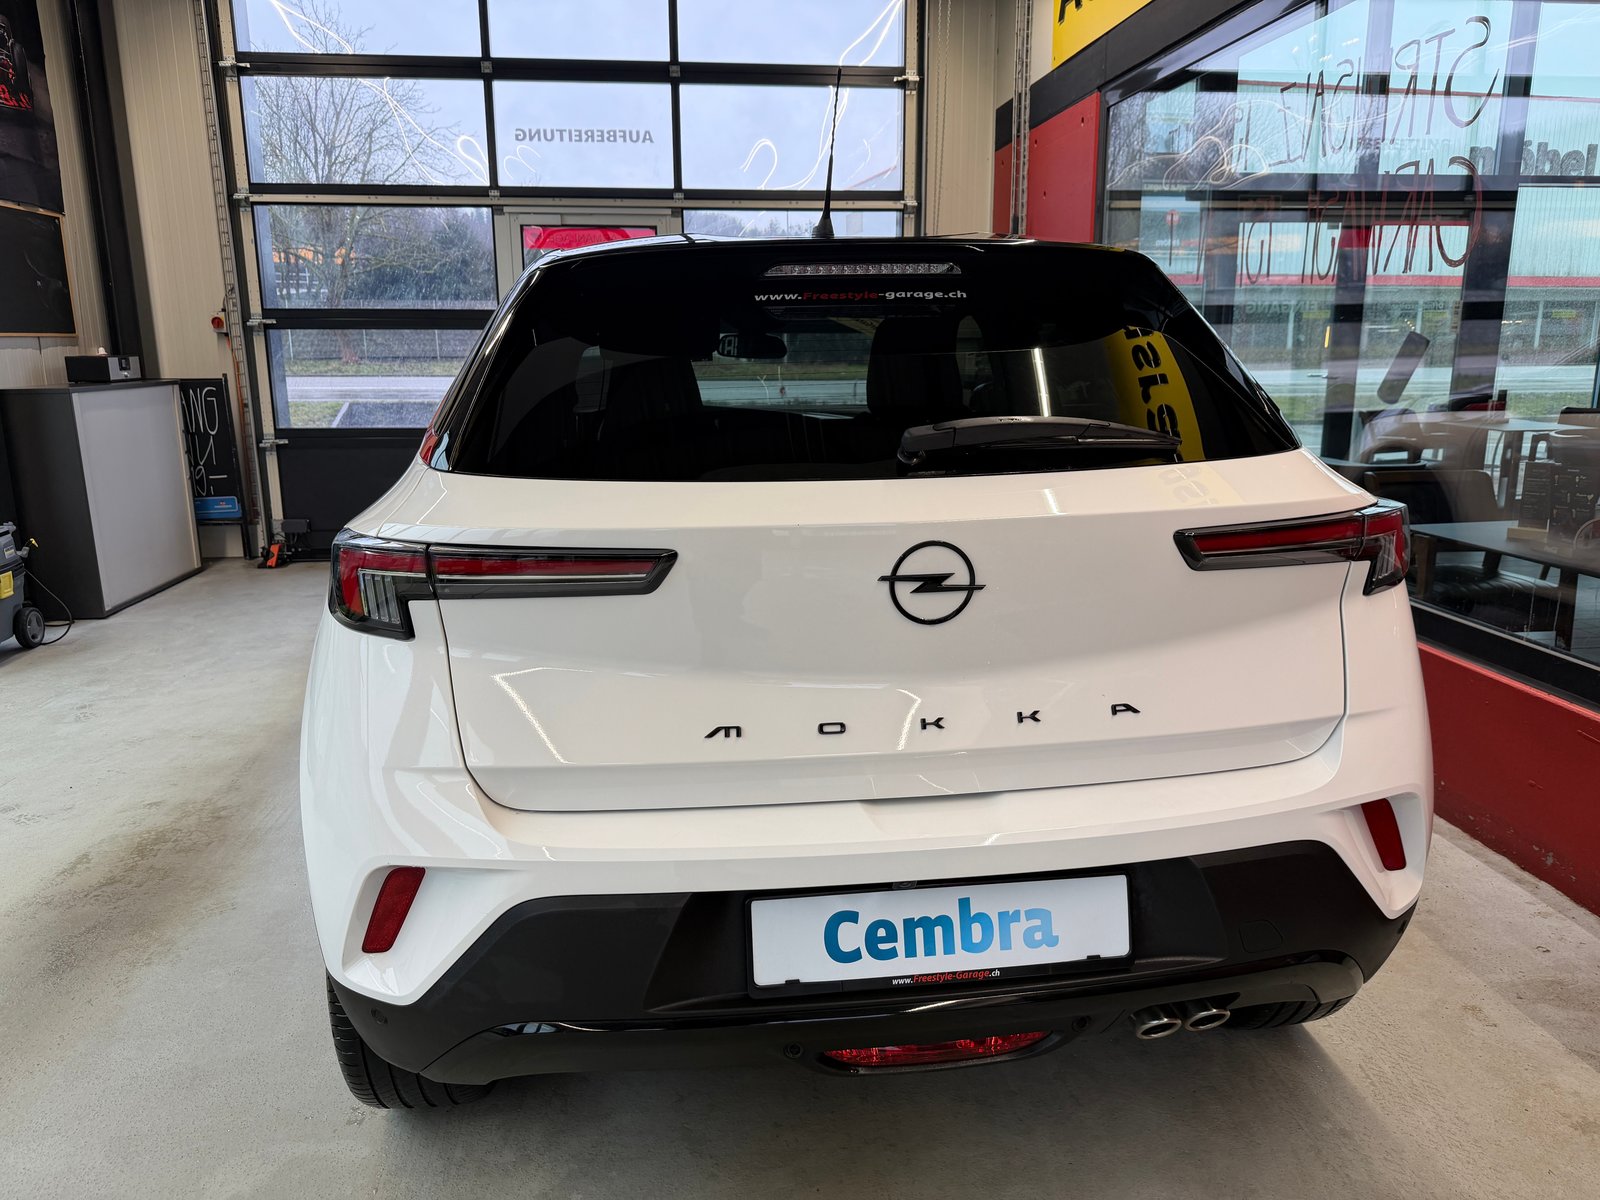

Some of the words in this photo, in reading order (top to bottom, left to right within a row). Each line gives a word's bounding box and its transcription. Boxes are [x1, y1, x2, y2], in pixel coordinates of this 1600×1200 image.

[754, 289, 967, 302] www.Freestyle-garage.ch
[704, 702, 1141, 739] MOKKA
[823, 896, 1060, 964] Cembra
[891, 968, 1001, 986] www.Freestyle-Garage.ch
